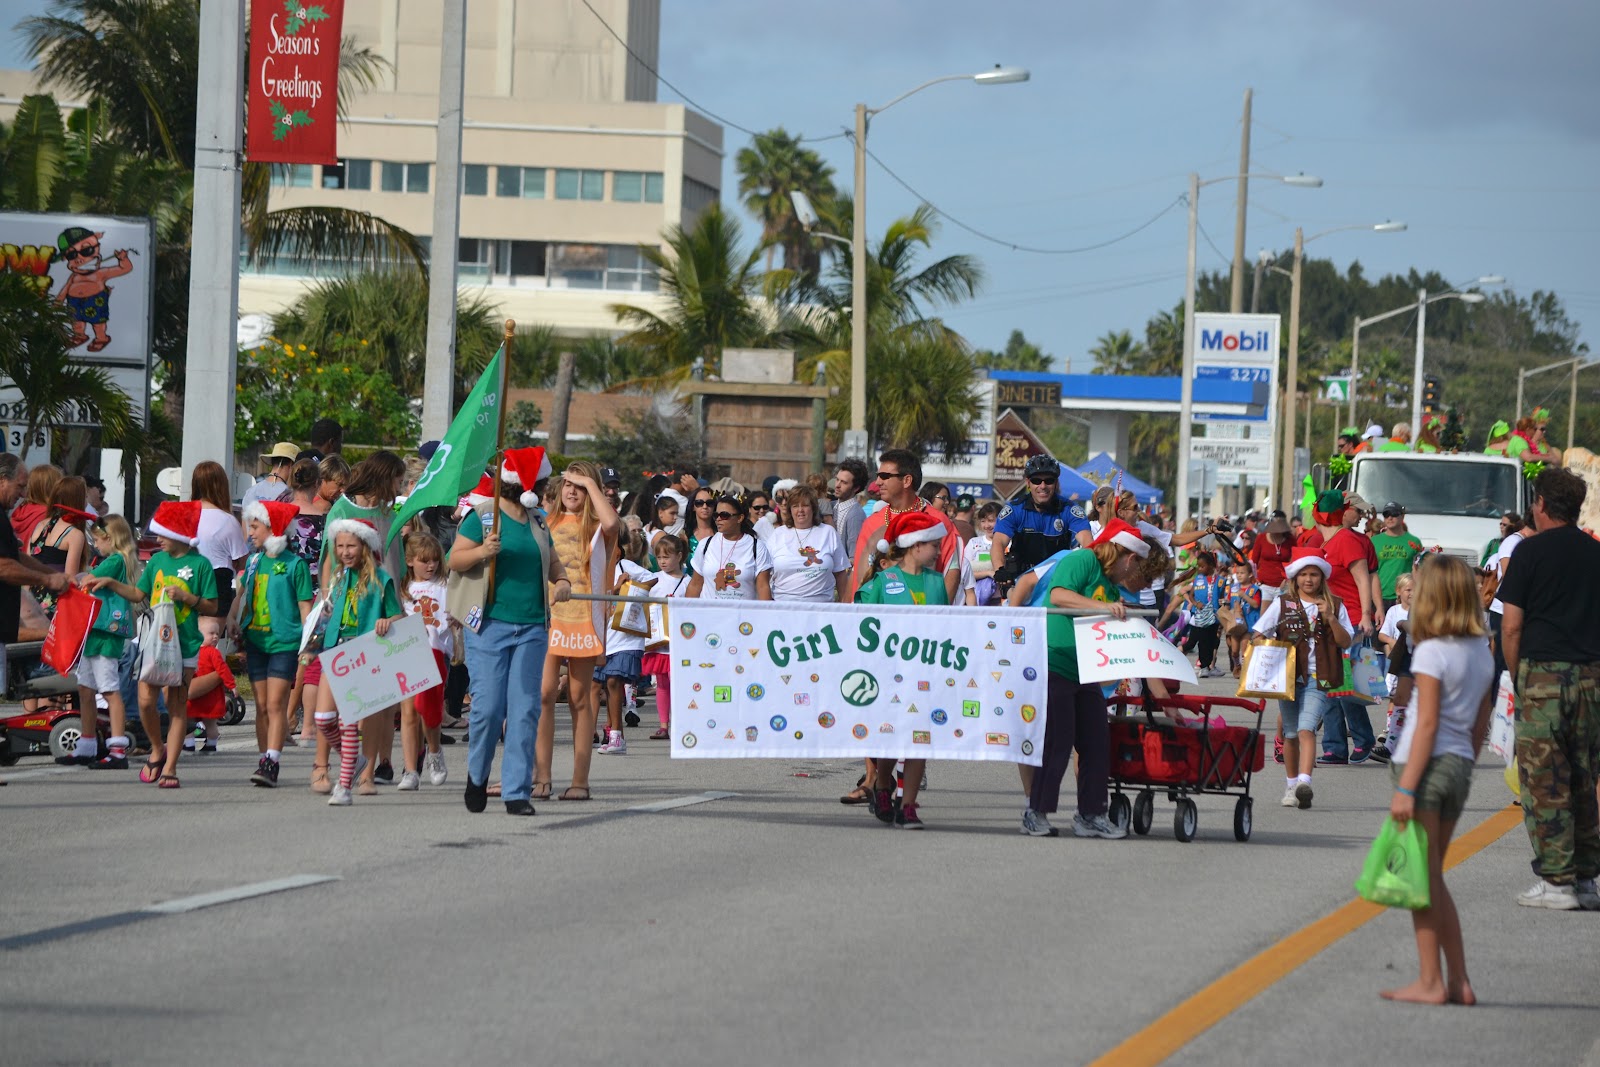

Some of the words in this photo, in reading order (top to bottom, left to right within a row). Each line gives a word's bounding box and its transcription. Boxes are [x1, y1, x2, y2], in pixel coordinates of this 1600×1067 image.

[267, 13, 320, 56] Season's
[261, 56, 322, 108] Greetings
[1201, 329, 1269, 352] Mobil
[997, 383, 1057, 405] DINETTE
[996, 434, 1029, 451] loors
[956, 485, 983, 497] 342
[766, 624, 843, 667] Girl
[857, 616, 969, 672] Scouts
[331, 650, 367, 677] Girl
